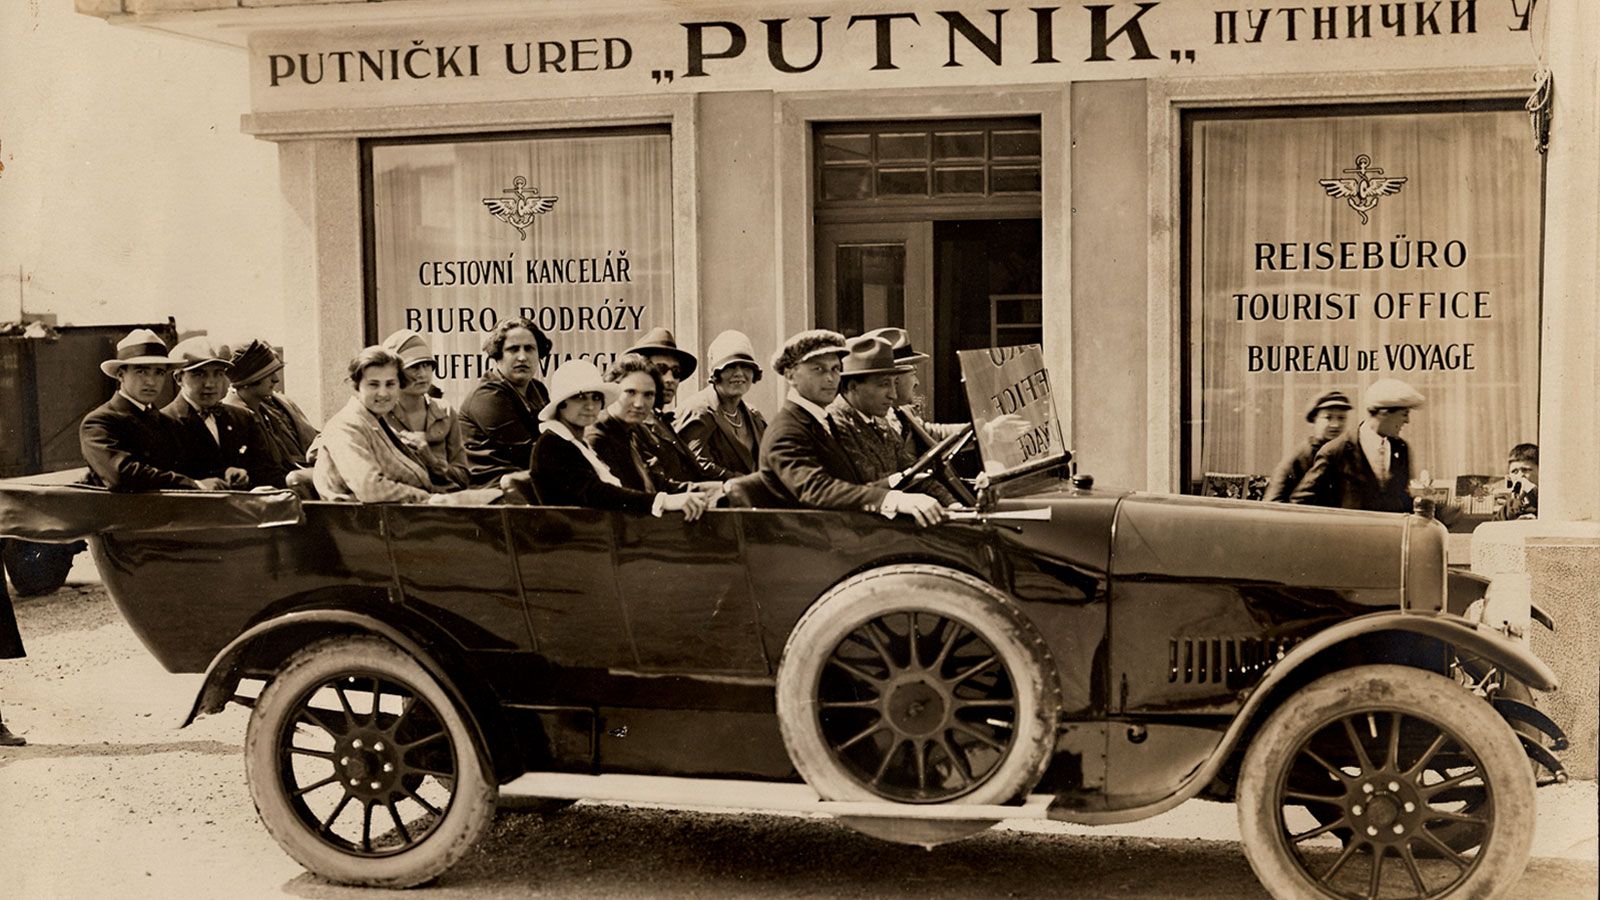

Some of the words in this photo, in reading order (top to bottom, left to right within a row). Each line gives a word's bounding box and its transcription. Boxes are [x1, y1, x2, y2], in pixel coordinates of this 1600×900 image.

[1214, 0, 1477, 45] ПУТНИЧКИ
[269, 40, 480, 87] PUTNIČKI
[505, 37, 633, 75] URED
[419, 252, 515, 286] CESTOVNÍ
[527, 250, 632, 284] KANCELÁŘ
[1255, 234, 1466, 271] REISEBÜRO
[406, 307, 498, 333] BIURO
[519, 298, 645, 332] PODRÓŻY
[1233, 293, 1360, 321] TOURIST
[1374, 291, 1492, 319] OFFICE
[1248, 345, 1349, 372] BUREAU
[1357, 350, 1379, 371] DE
[1384, 343, 1475, 370] VOYAGE
